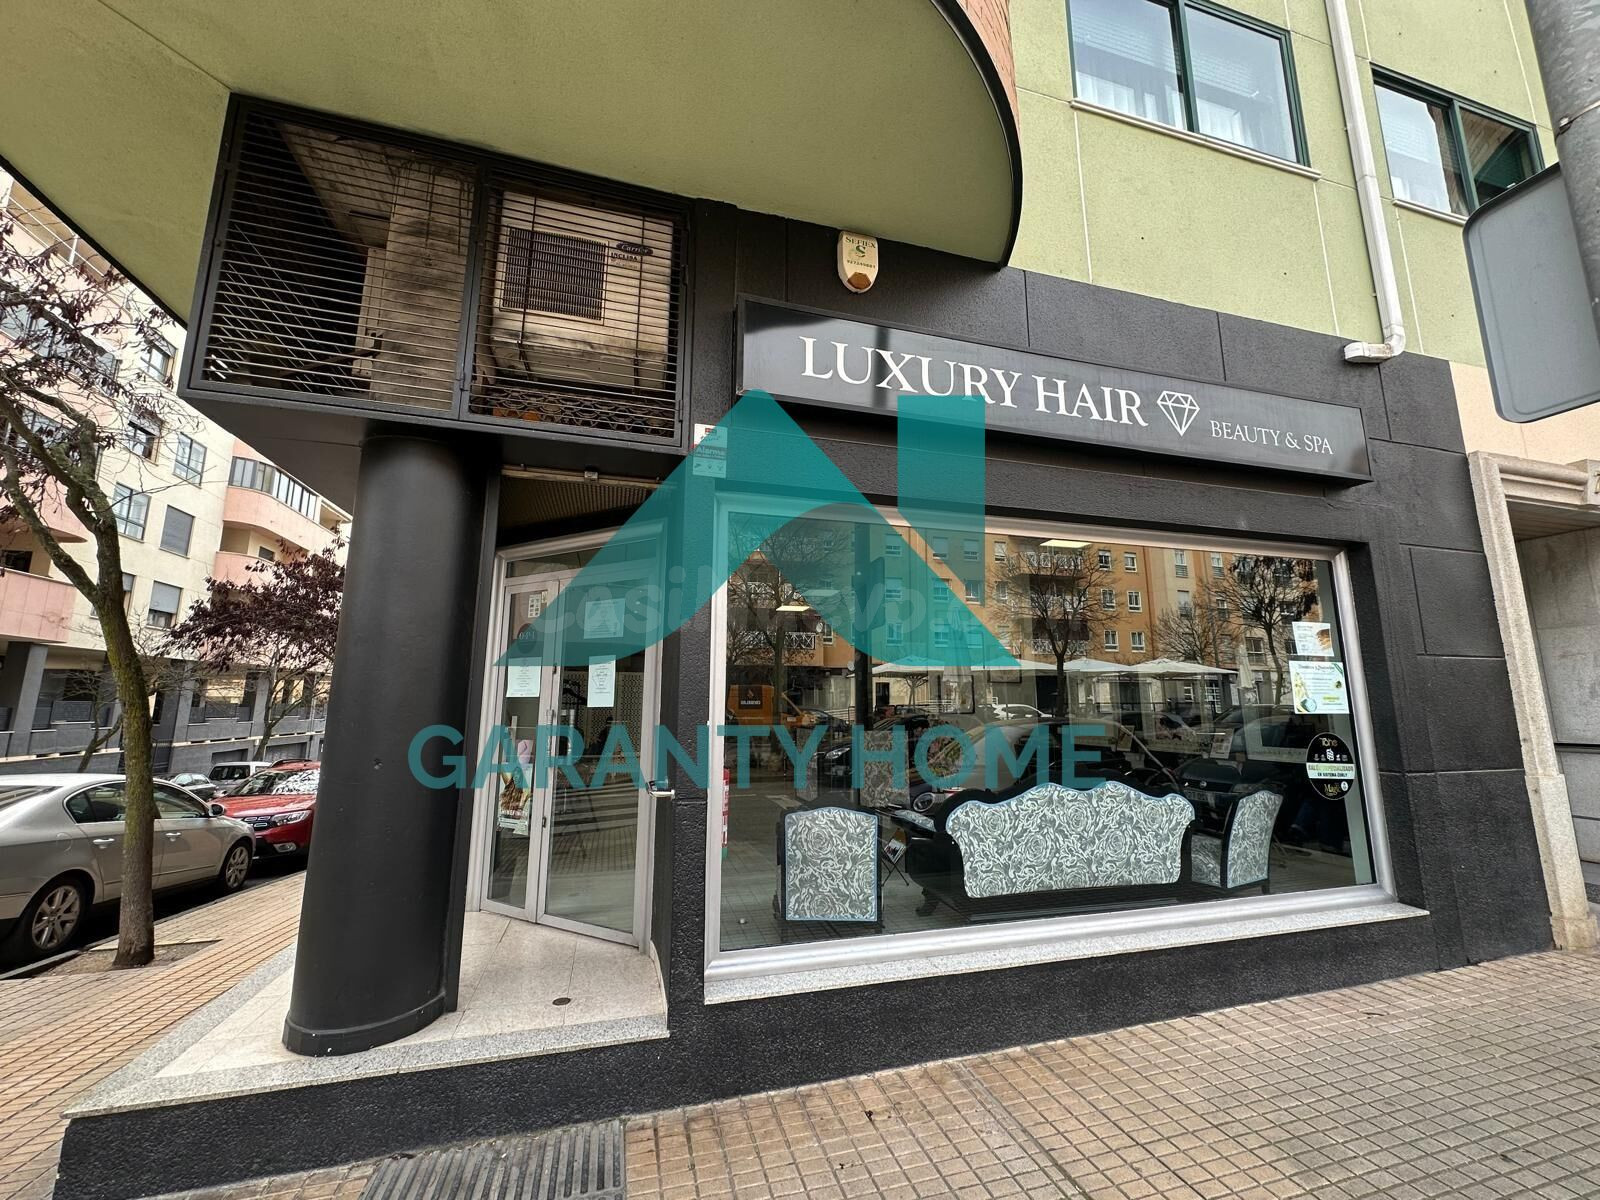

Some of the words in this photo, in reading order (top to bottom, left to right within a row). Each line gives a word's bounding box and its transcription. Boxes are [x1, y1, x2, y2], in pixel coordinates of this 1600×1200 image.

[800, 336, 1021, 410] LUXURY
[1033, 374, 1149, 427] HAIR
[1209, 419, 1281, 447] BEAUTY
[1285, 431, 1301, 450] &
[1303, 434, 1334, 455] SPA
